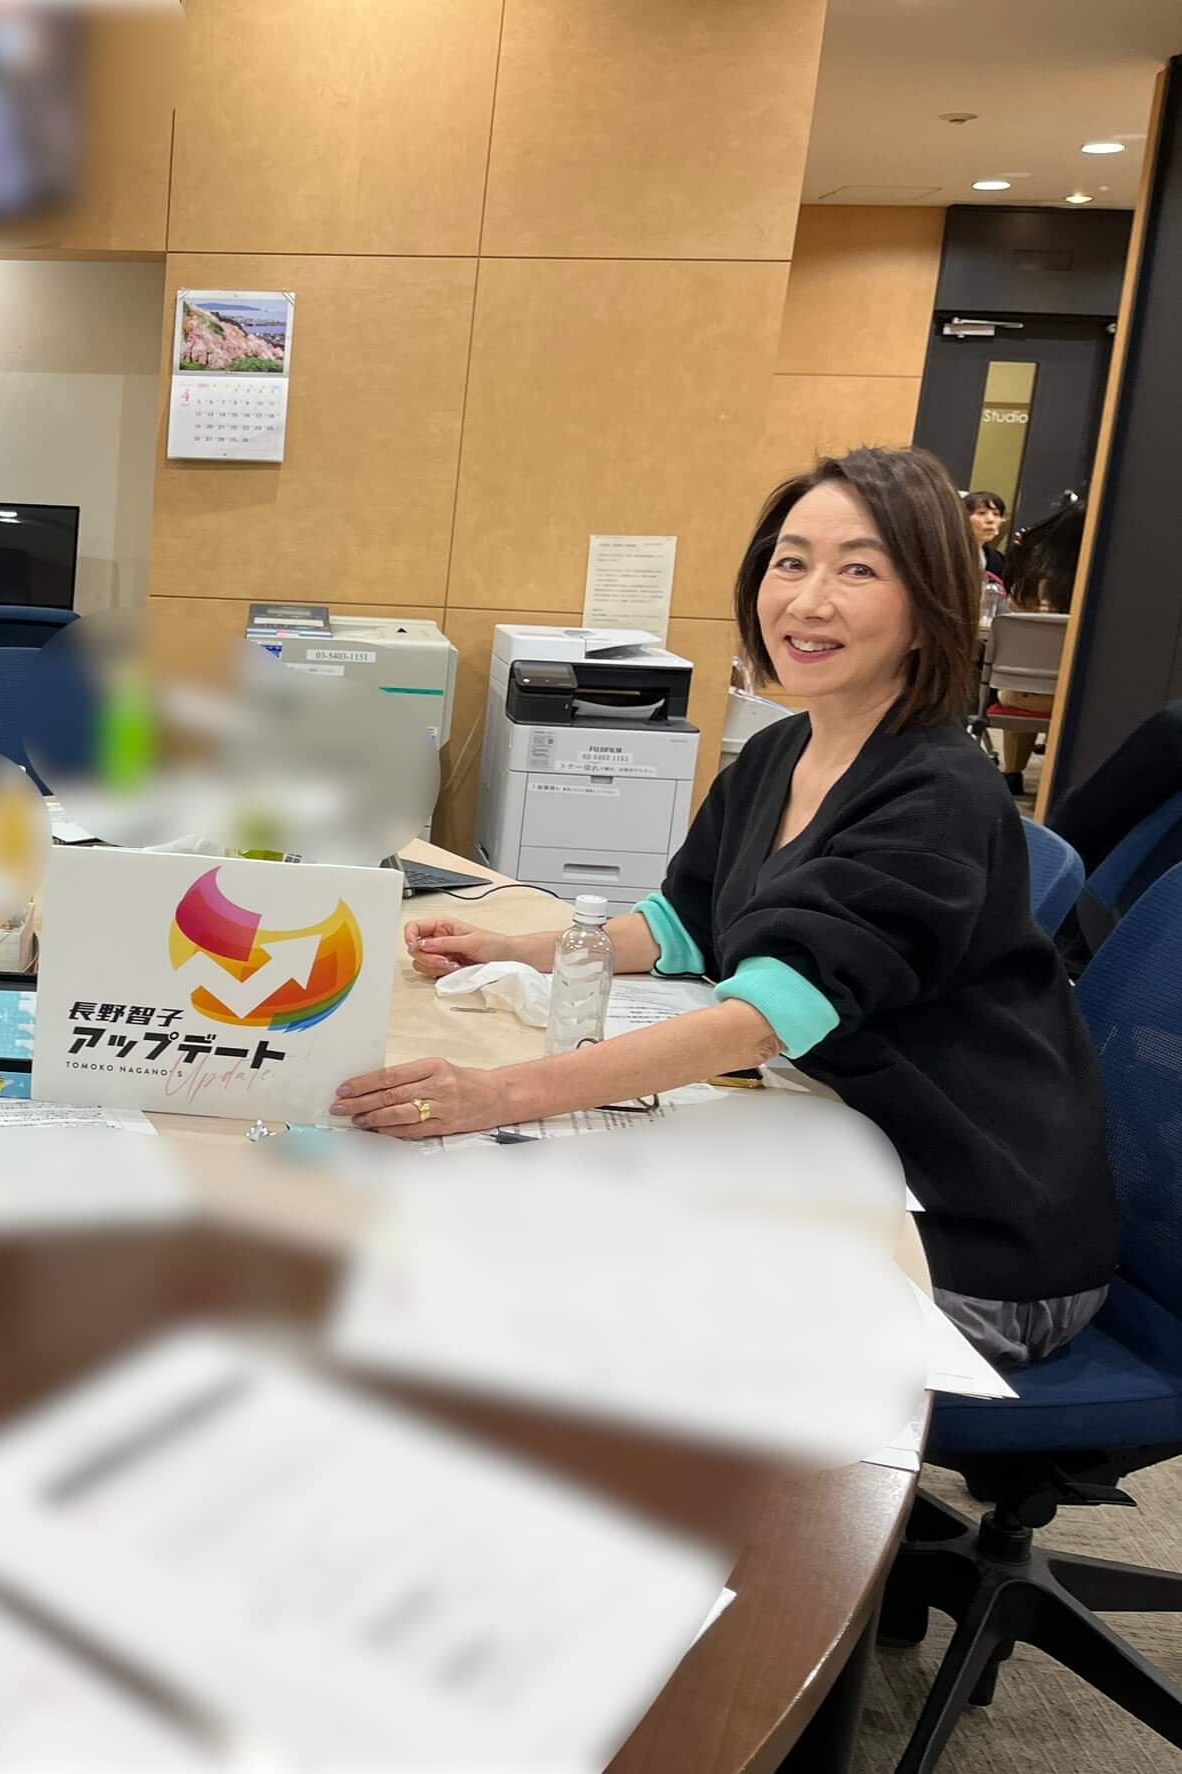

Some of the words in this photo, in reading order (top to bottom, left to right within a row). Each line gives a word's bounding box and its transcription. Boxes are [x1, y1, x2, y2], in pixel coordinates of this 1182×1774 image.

[983, 410, 1029, 424] Studio
[68, 1001, 184, 1027] 長野智子
[68, 1026, 286, 1069] アップデート
[66, 1061, 114, 1072] TOMOKO
[164, 1049, 275, 1104] Update
